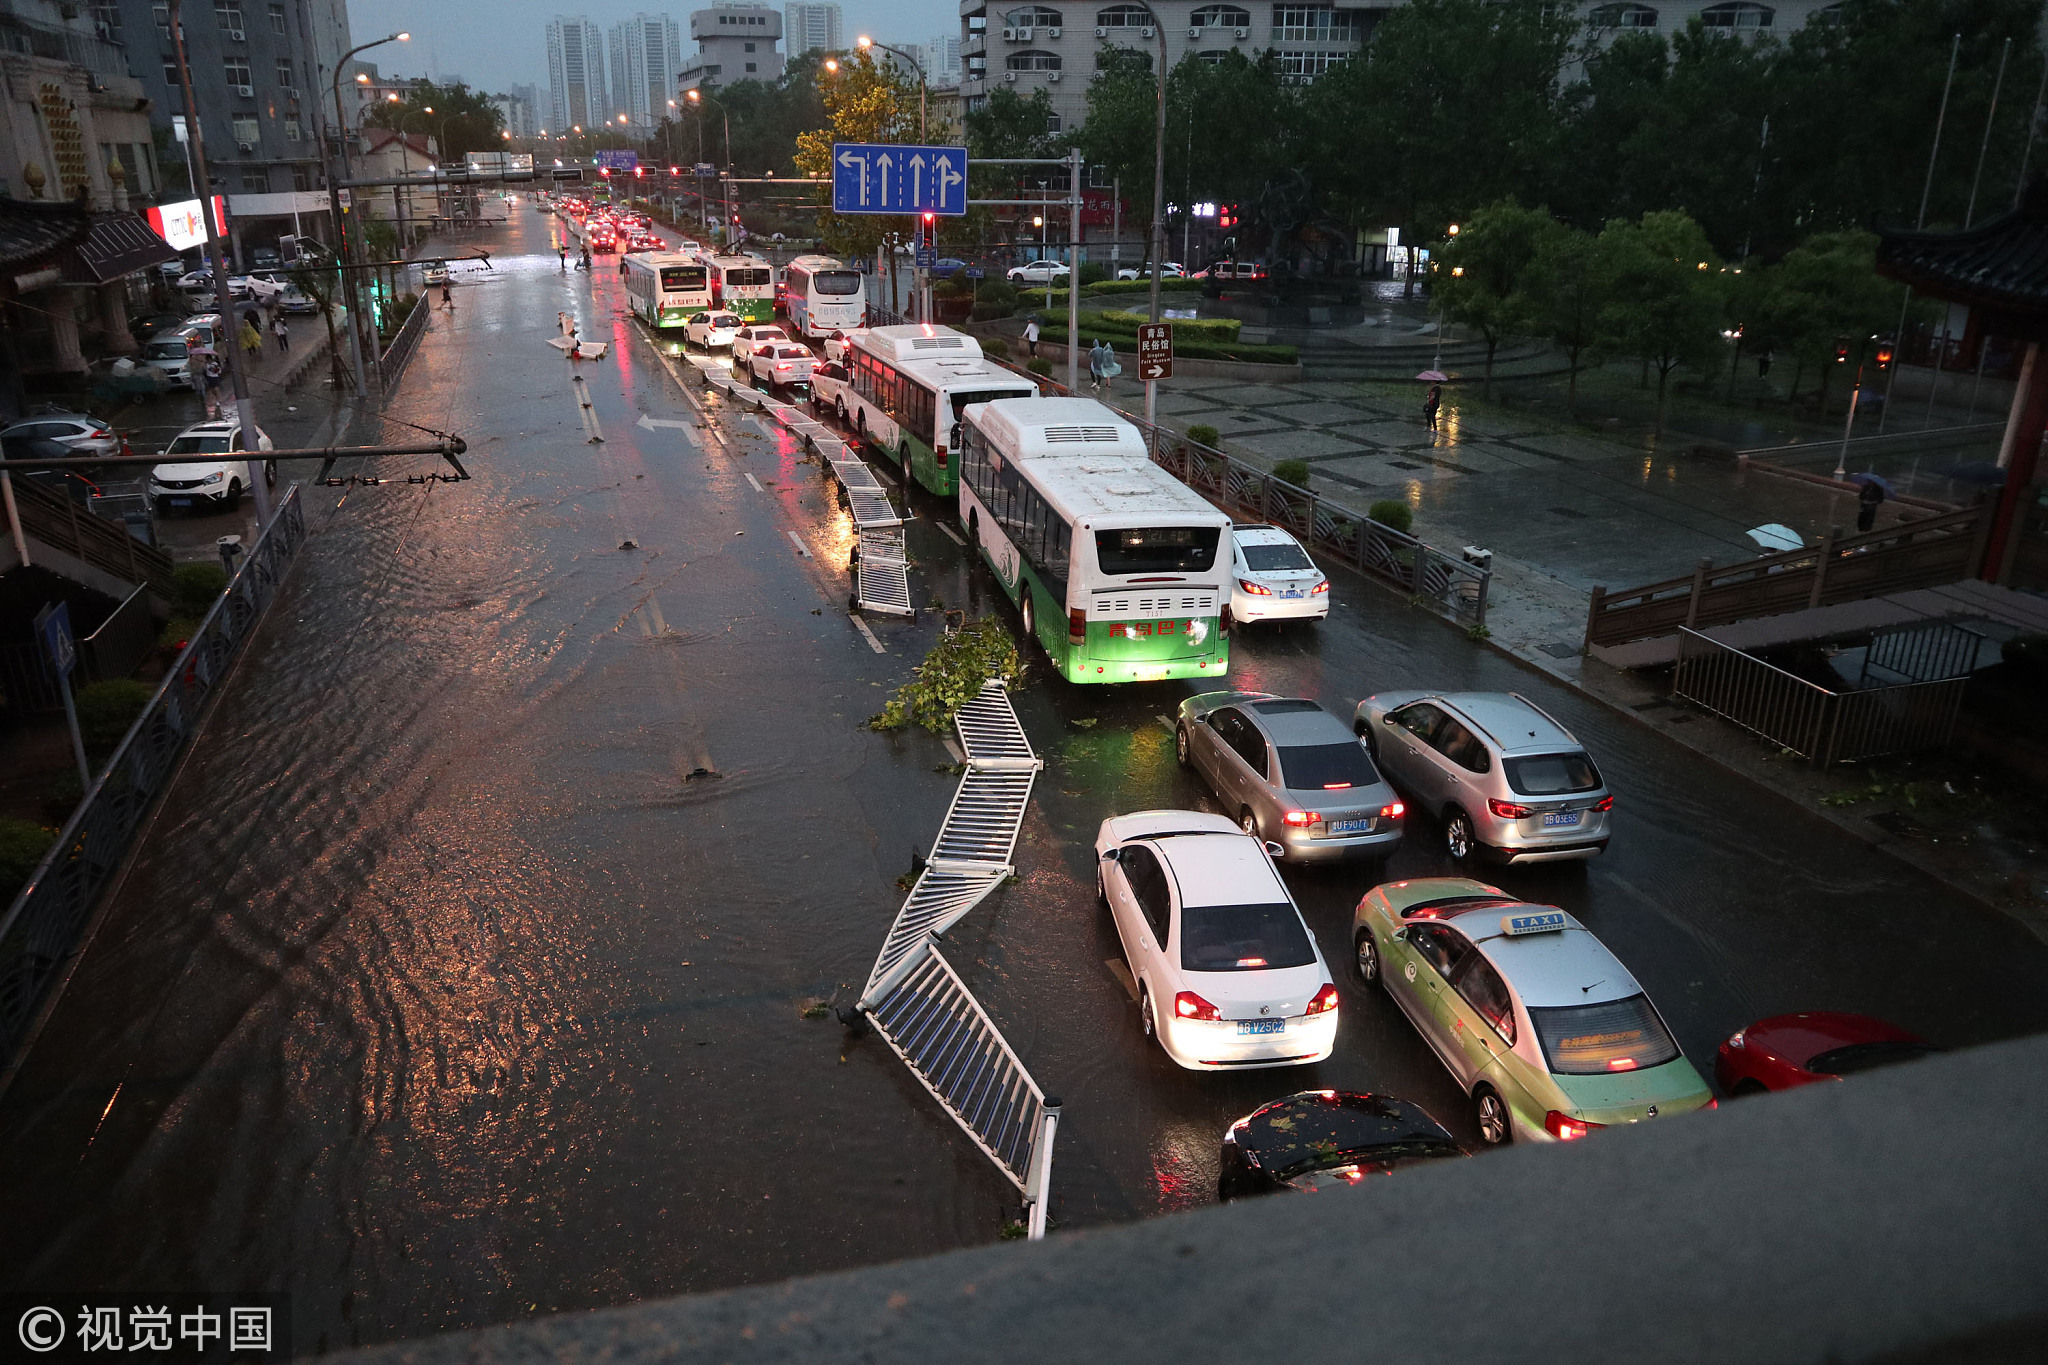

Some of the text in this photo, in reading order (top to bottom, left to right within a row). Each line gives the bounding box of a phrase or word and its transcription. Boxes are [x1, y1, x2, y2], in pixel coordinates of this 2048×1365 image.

[1147, 327, 1165, 339] 青岛
[1142, 339, 1170, 351] 民俗馆
[1517, 914, 1559, 927] TAXI
